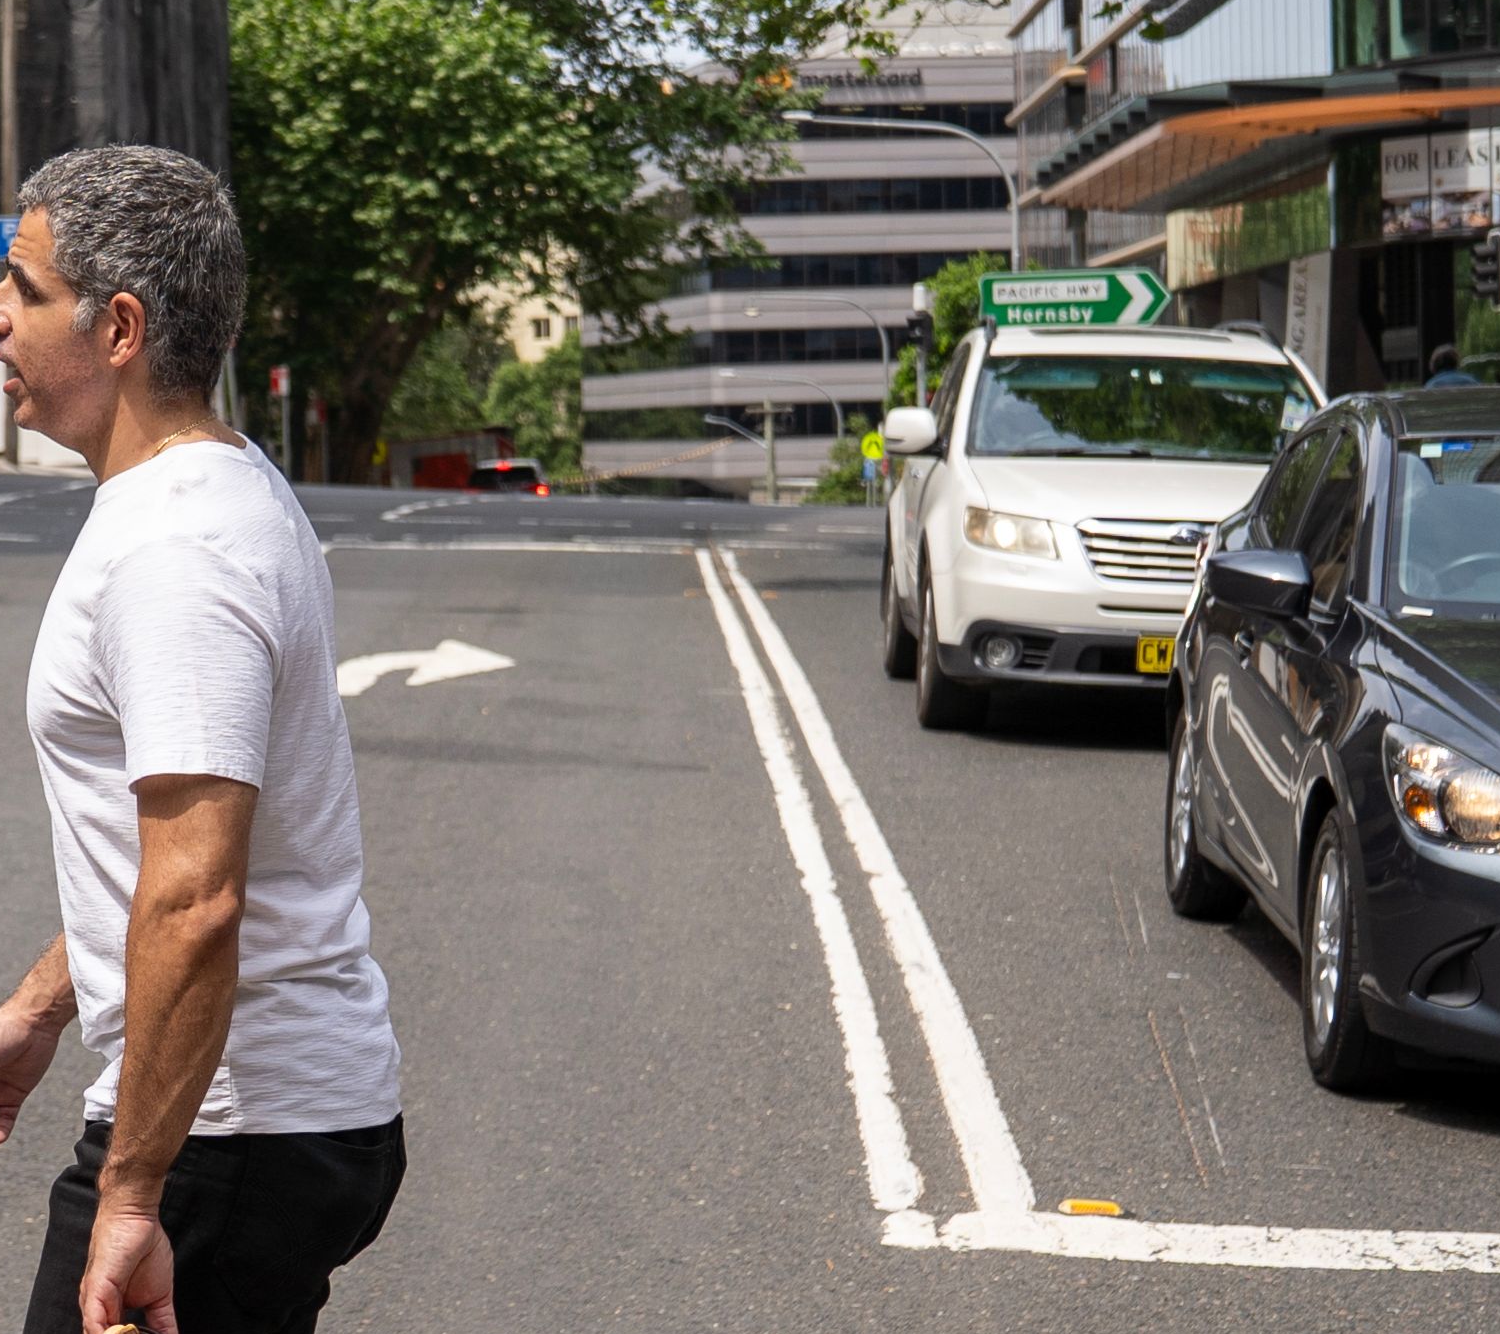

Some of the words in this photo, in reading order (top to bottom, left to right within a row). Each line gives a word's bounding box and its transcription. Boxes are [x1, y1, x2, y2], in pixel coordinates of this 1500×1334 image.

[802, 67, 922, 87] mastercard
[1384, 152, 1420, 173] FOR
[997, 286, 1060, 300] PACIFIC
[1067, 284, 1101, 298] HWY
[1007, 305, 1094, 324] Hornsby
